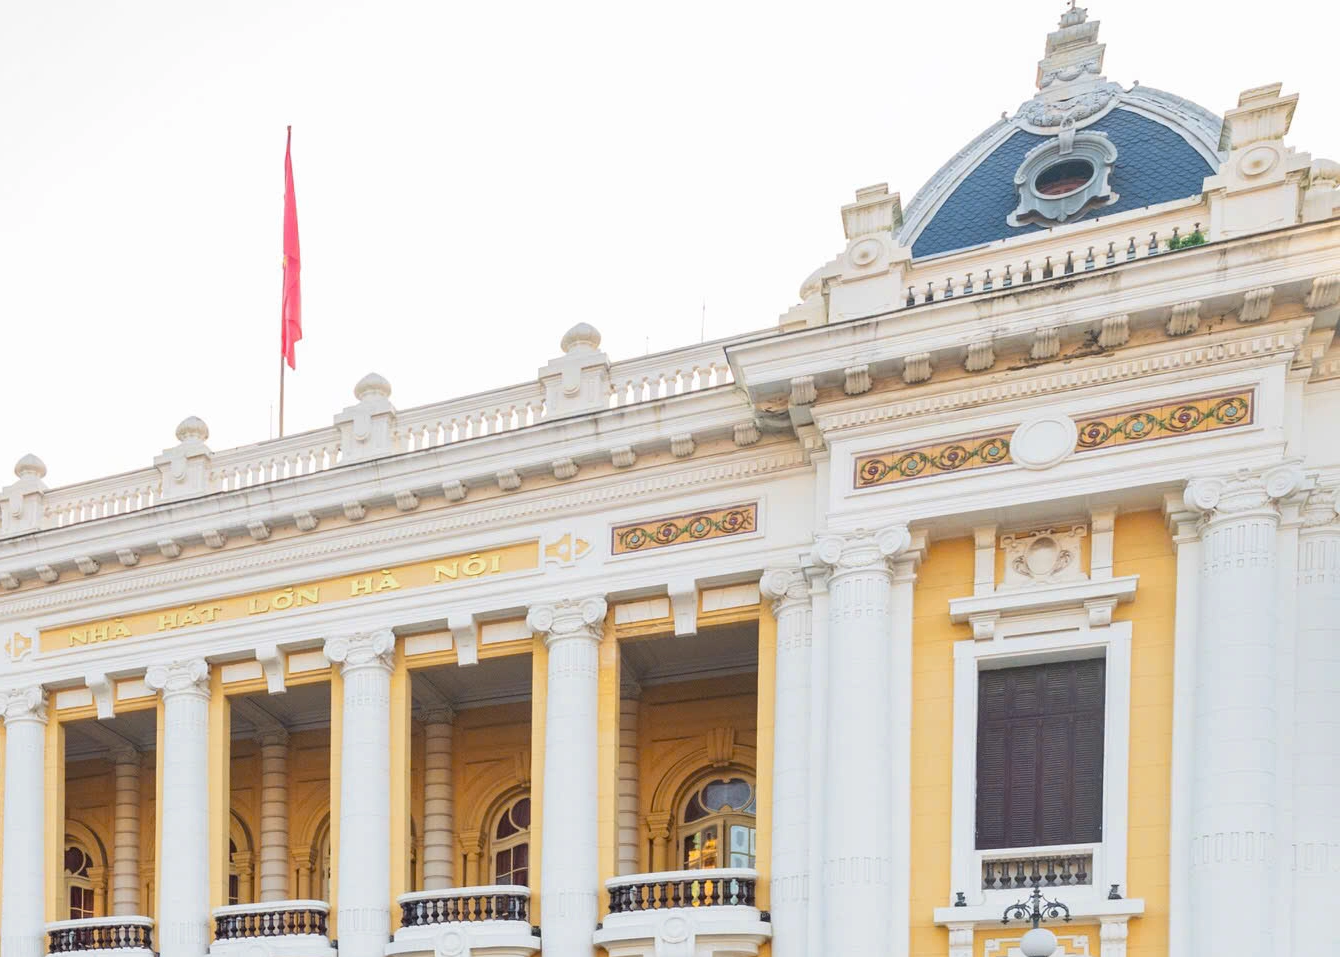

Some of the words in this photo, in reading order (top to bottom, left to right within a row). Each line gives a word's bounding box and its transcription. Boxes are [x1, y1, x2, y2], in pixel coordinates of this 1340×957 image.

[68, 617, 133, 647] NHÀ
[157, 604, 223, 632] HÁT
[248, 585, 321, 615] LỚN
[350, 569, 401, 597] HÀ
